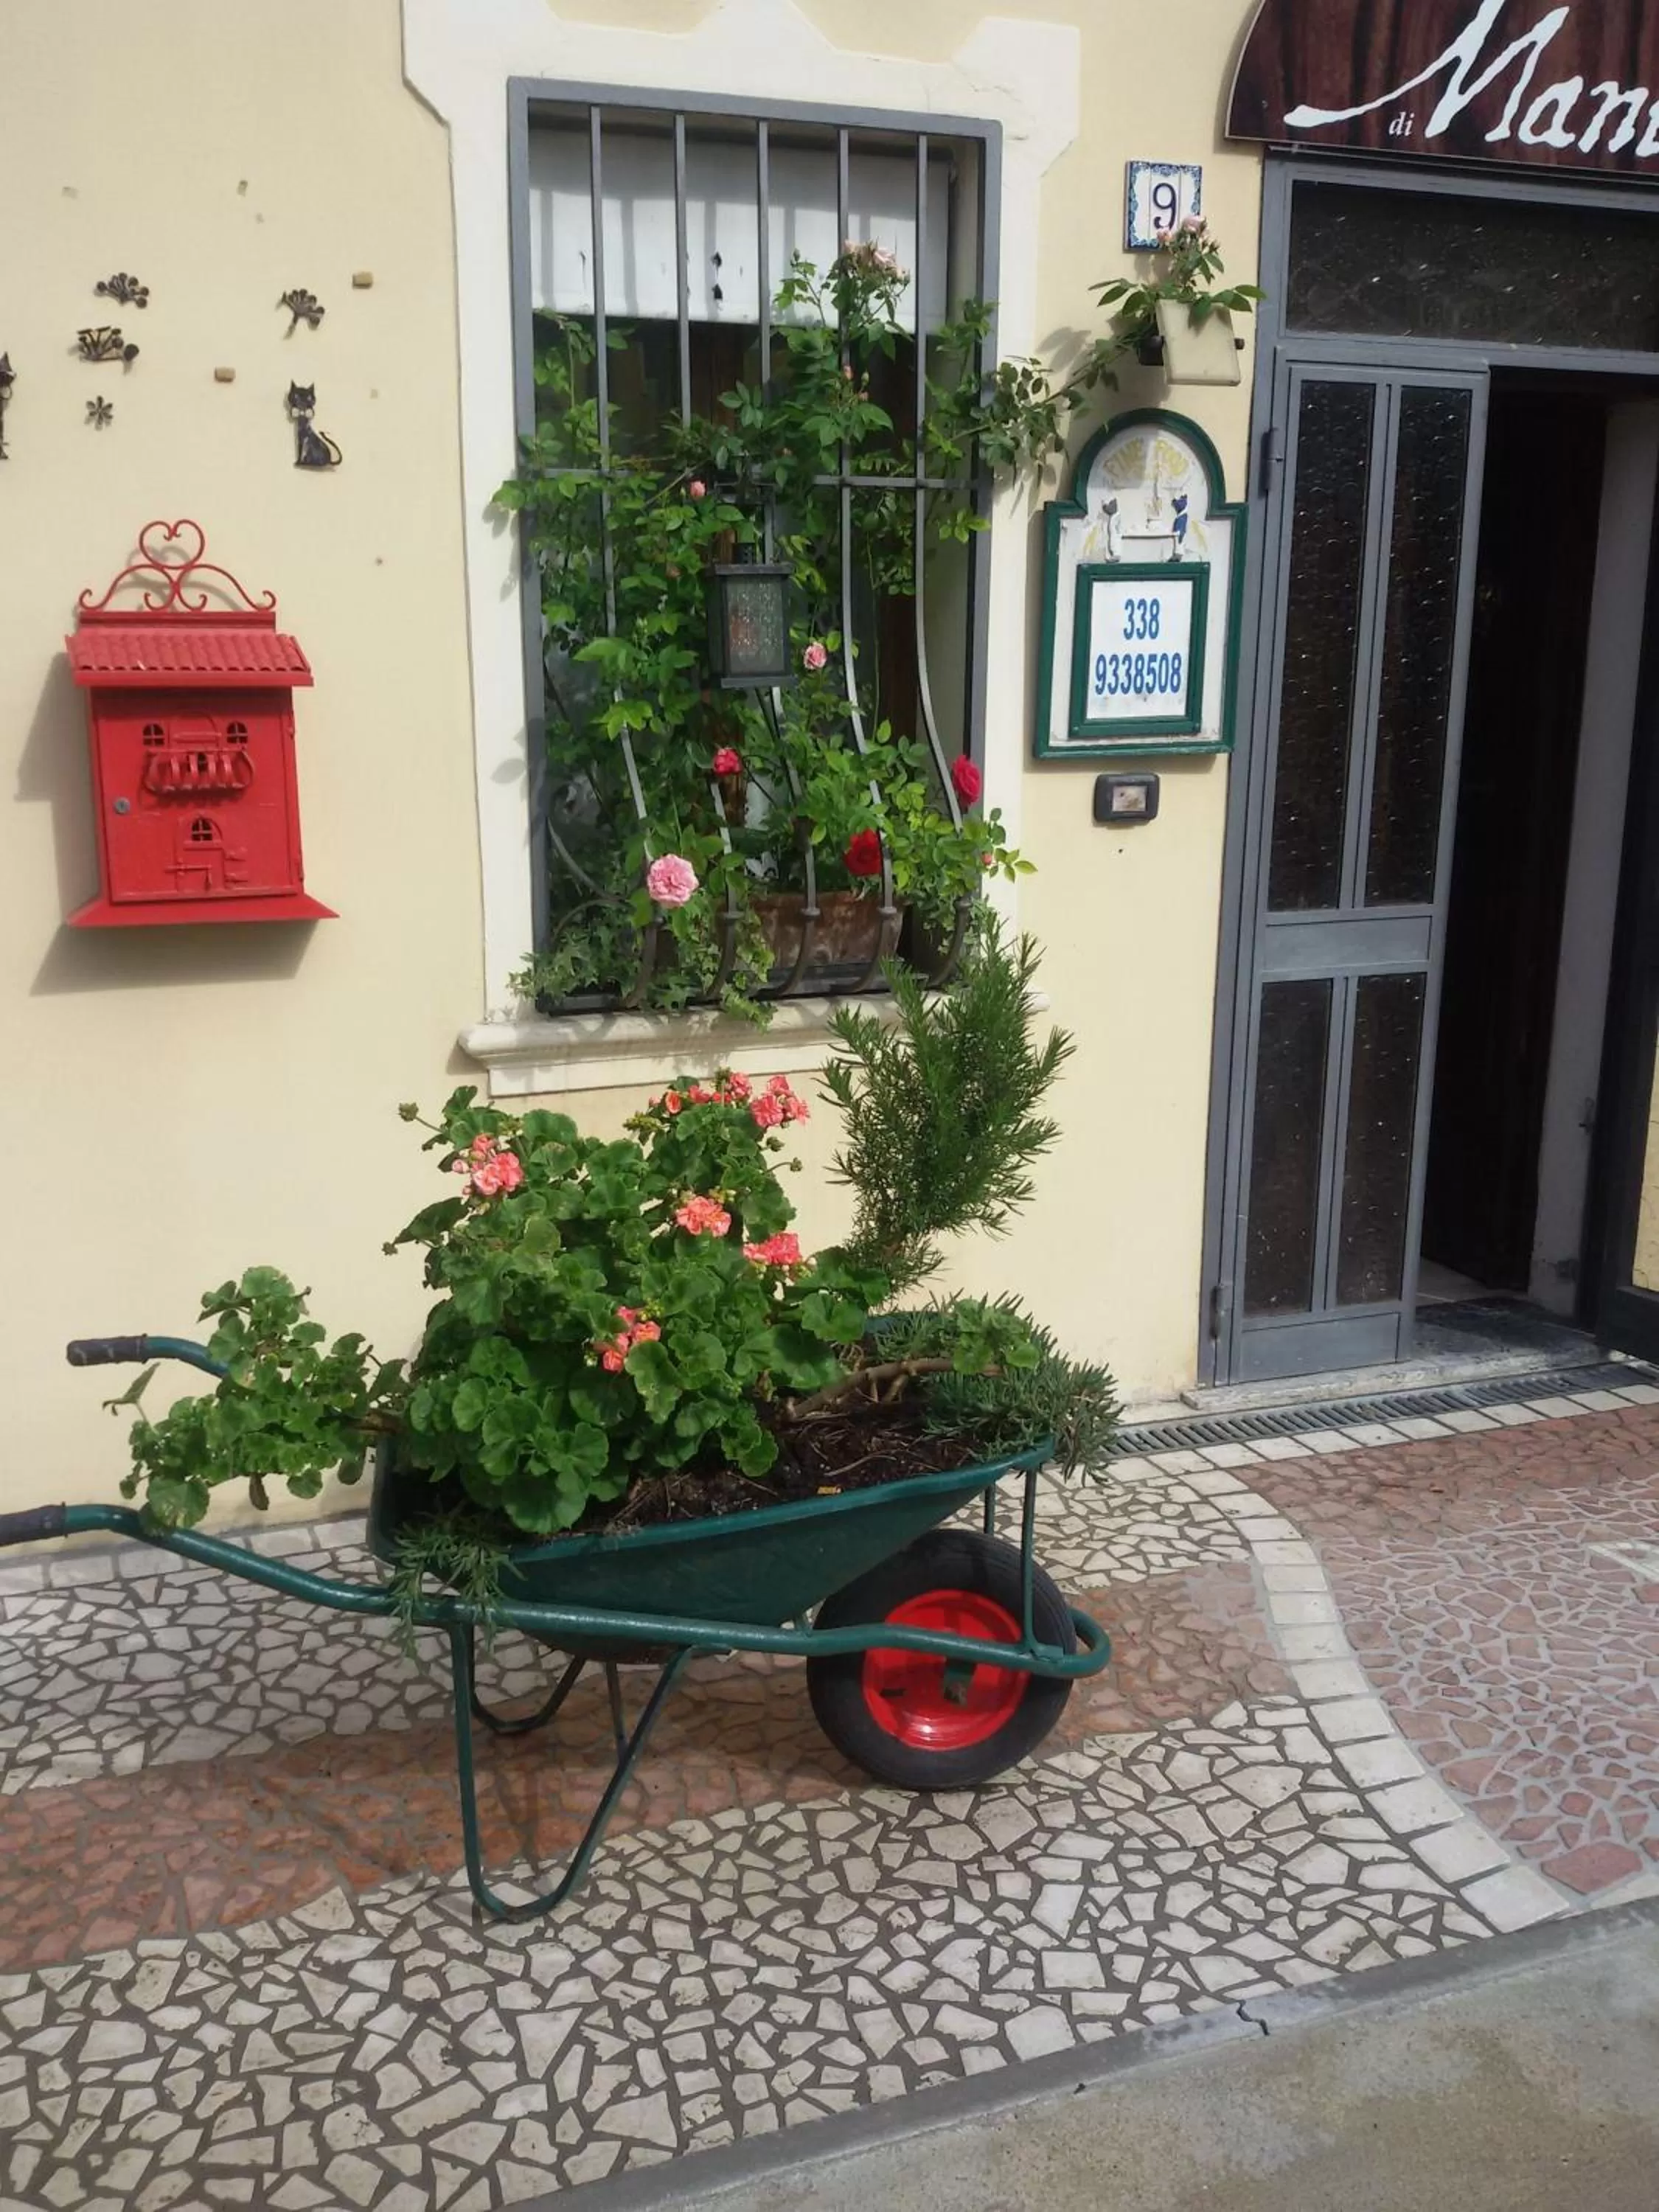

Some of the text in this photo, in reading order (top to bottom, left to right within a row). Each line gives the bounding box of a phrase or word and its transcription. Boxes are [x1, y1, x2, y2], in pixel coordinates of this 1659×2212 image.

[1389, 111, 1415, 136] di
[1152, 182, 1177, 231] 9
[1123, 598, 1160, 640] 338
[1095, 652, 1182, 695] 9338508
